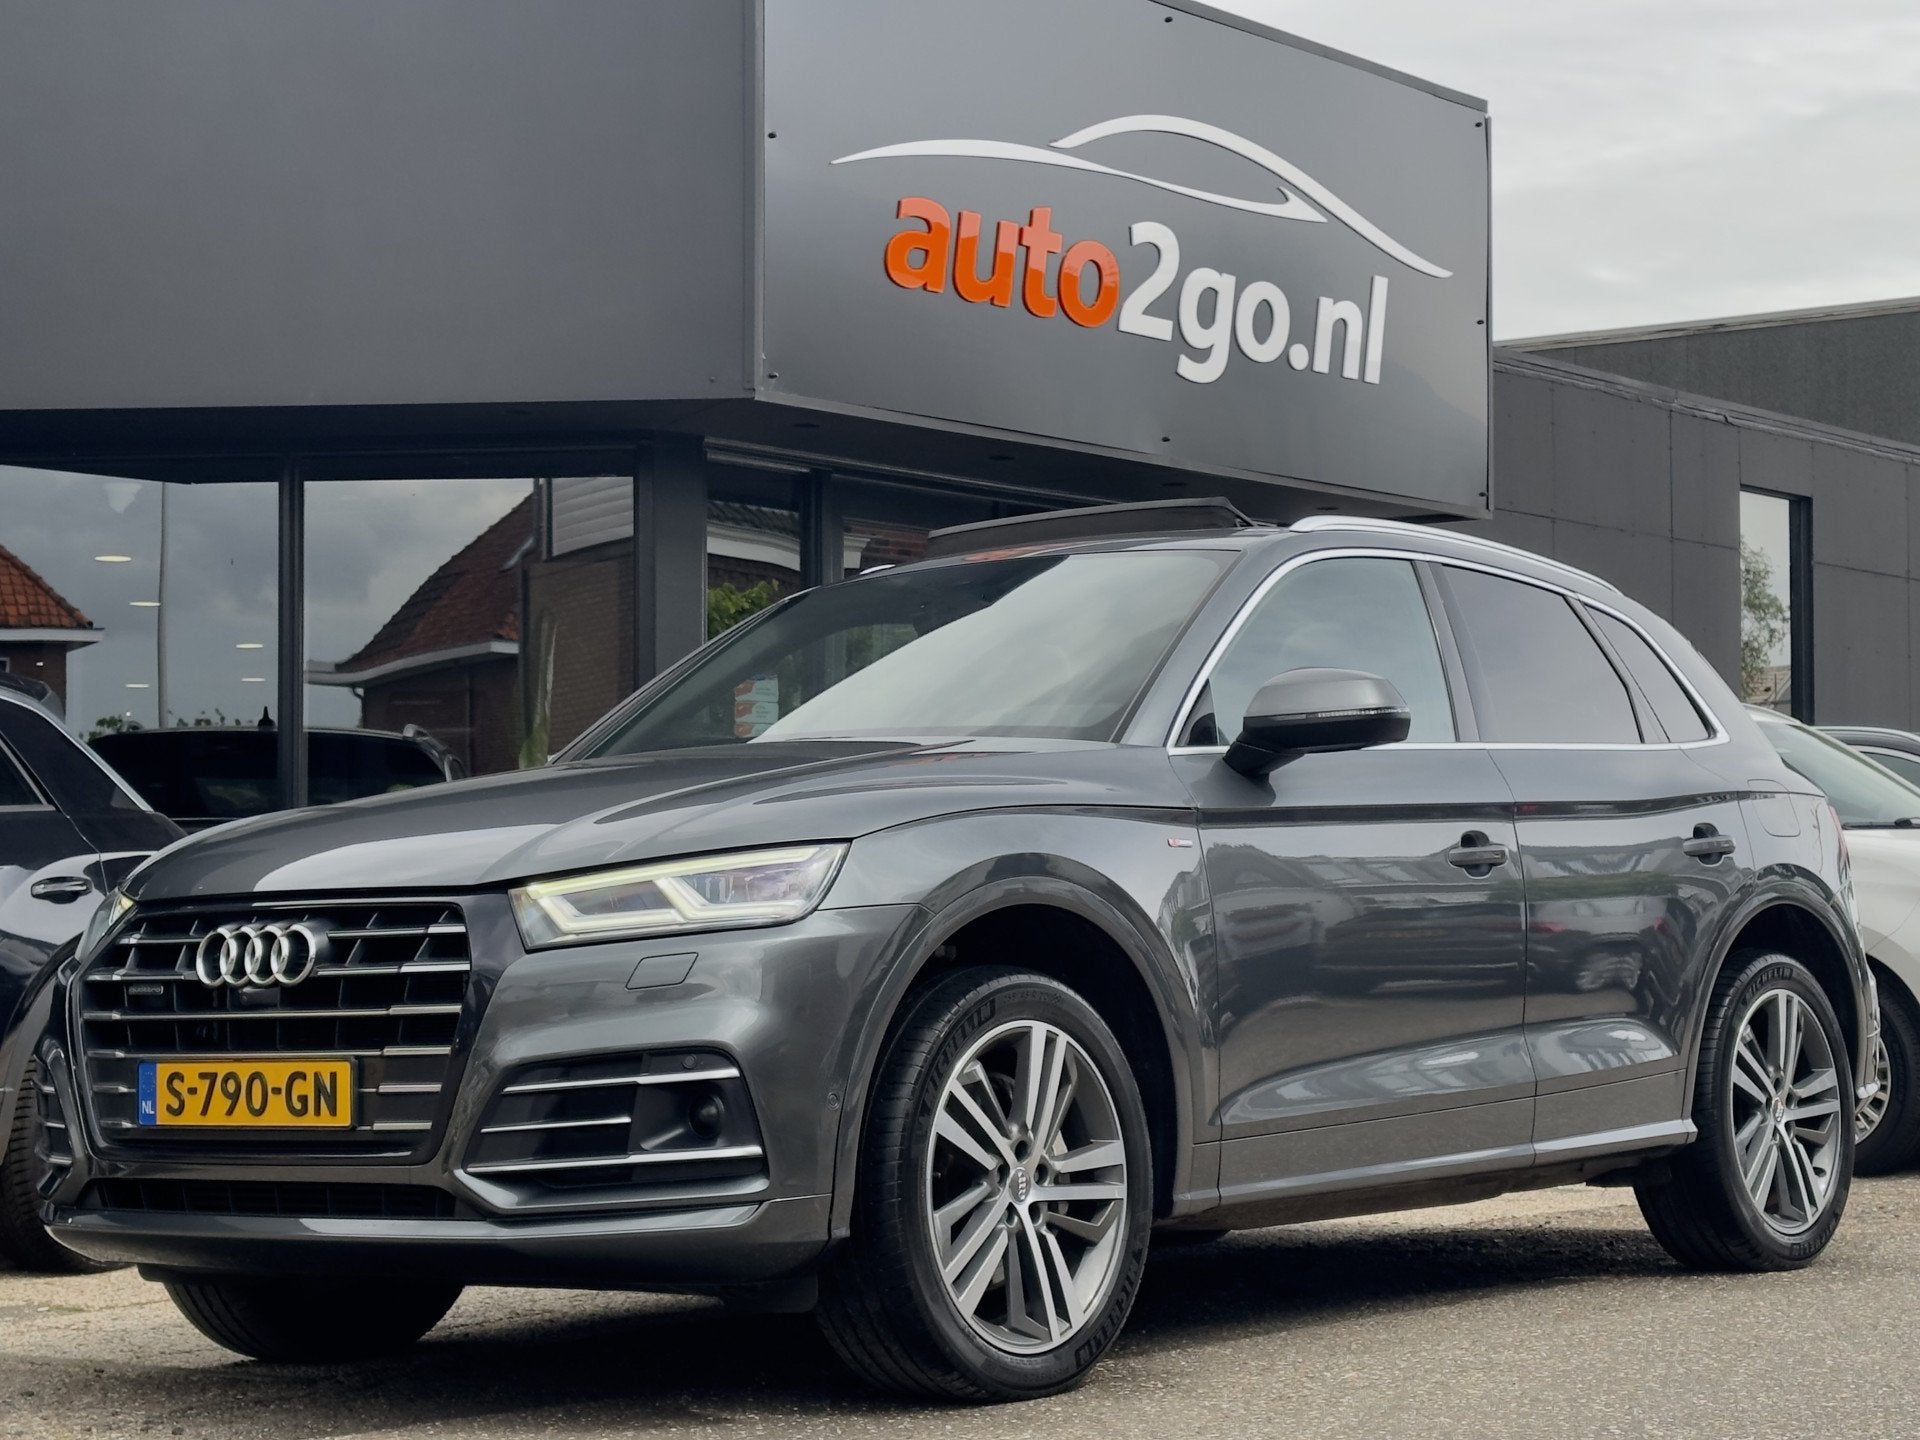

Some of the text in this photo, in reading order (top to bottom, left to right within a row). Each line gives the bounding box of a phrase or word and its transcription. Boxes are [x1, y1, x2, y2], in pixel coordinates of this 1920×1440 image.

[884, 197, 1388, 384] auto2go.nl
[142, 1100, 155, 1115] NL
[165, 1071, 338, 1117] S-790-GN
